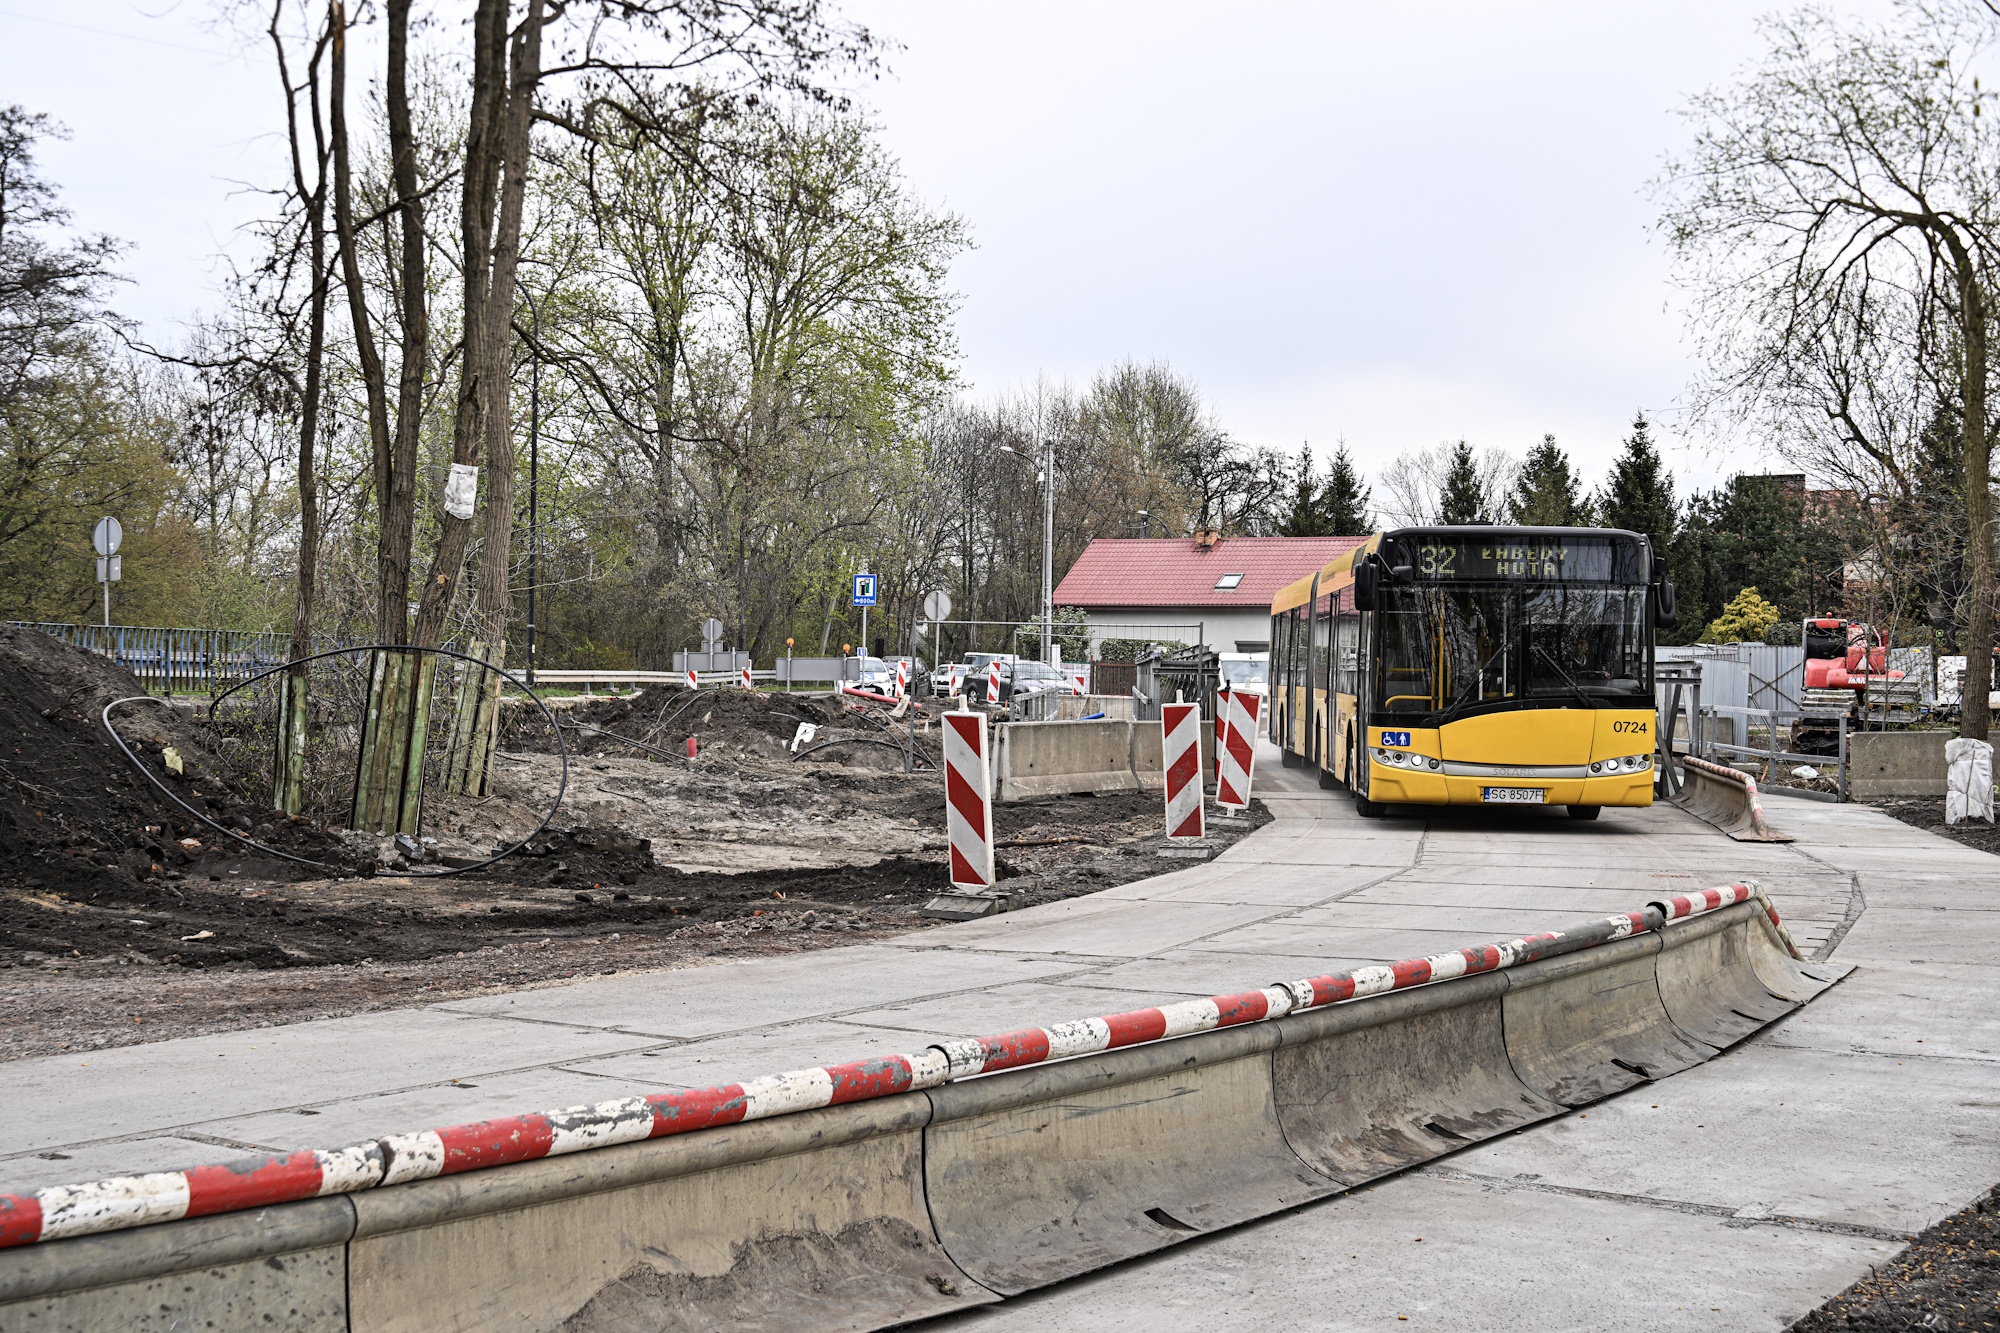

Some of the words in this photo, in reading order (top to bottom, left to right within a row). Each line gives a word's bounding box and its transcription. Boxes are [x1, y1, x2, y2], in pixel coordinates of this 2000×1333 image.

[1420, 545, 1457, 574] 32
[1497, 561, 1555, 575] HUTA
[1613, 720, 1648, 734] 0724
[1492, 768, 1537, 777] SOLARIS
[1491, 789, 1507, 800] SG
[1509, 789, 1542, 801] 8507F
